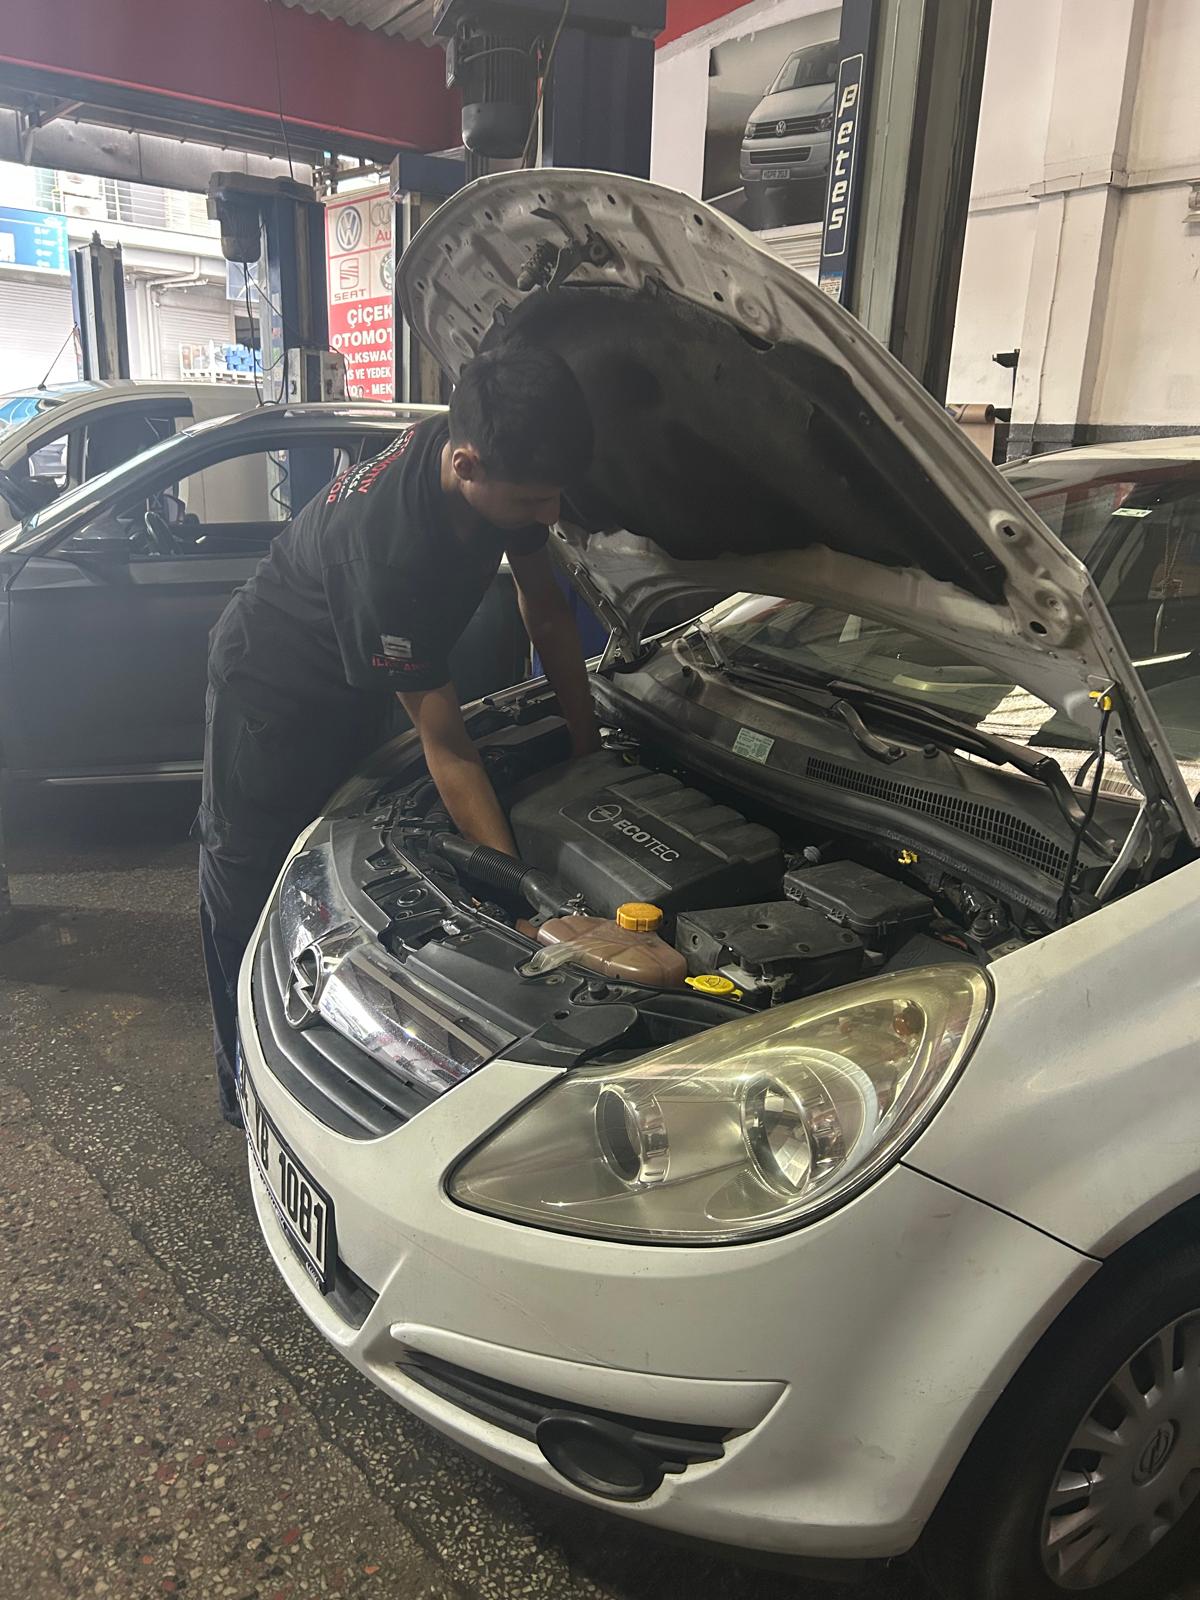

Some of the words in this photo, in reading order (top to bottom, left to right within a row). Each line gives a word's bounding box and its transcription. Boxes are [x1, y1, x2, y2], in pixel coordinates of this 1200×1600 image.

[334, 288, 367, 302] SEAT
[347, 304, 392, 329] ÇİÇEK
[355, 368, 365, 380] VE
[366, 366, 391, 378] YEDEK
[613, 819, 680, 862] ECOTEC
[279, 1150, 324, 1264] 1081
